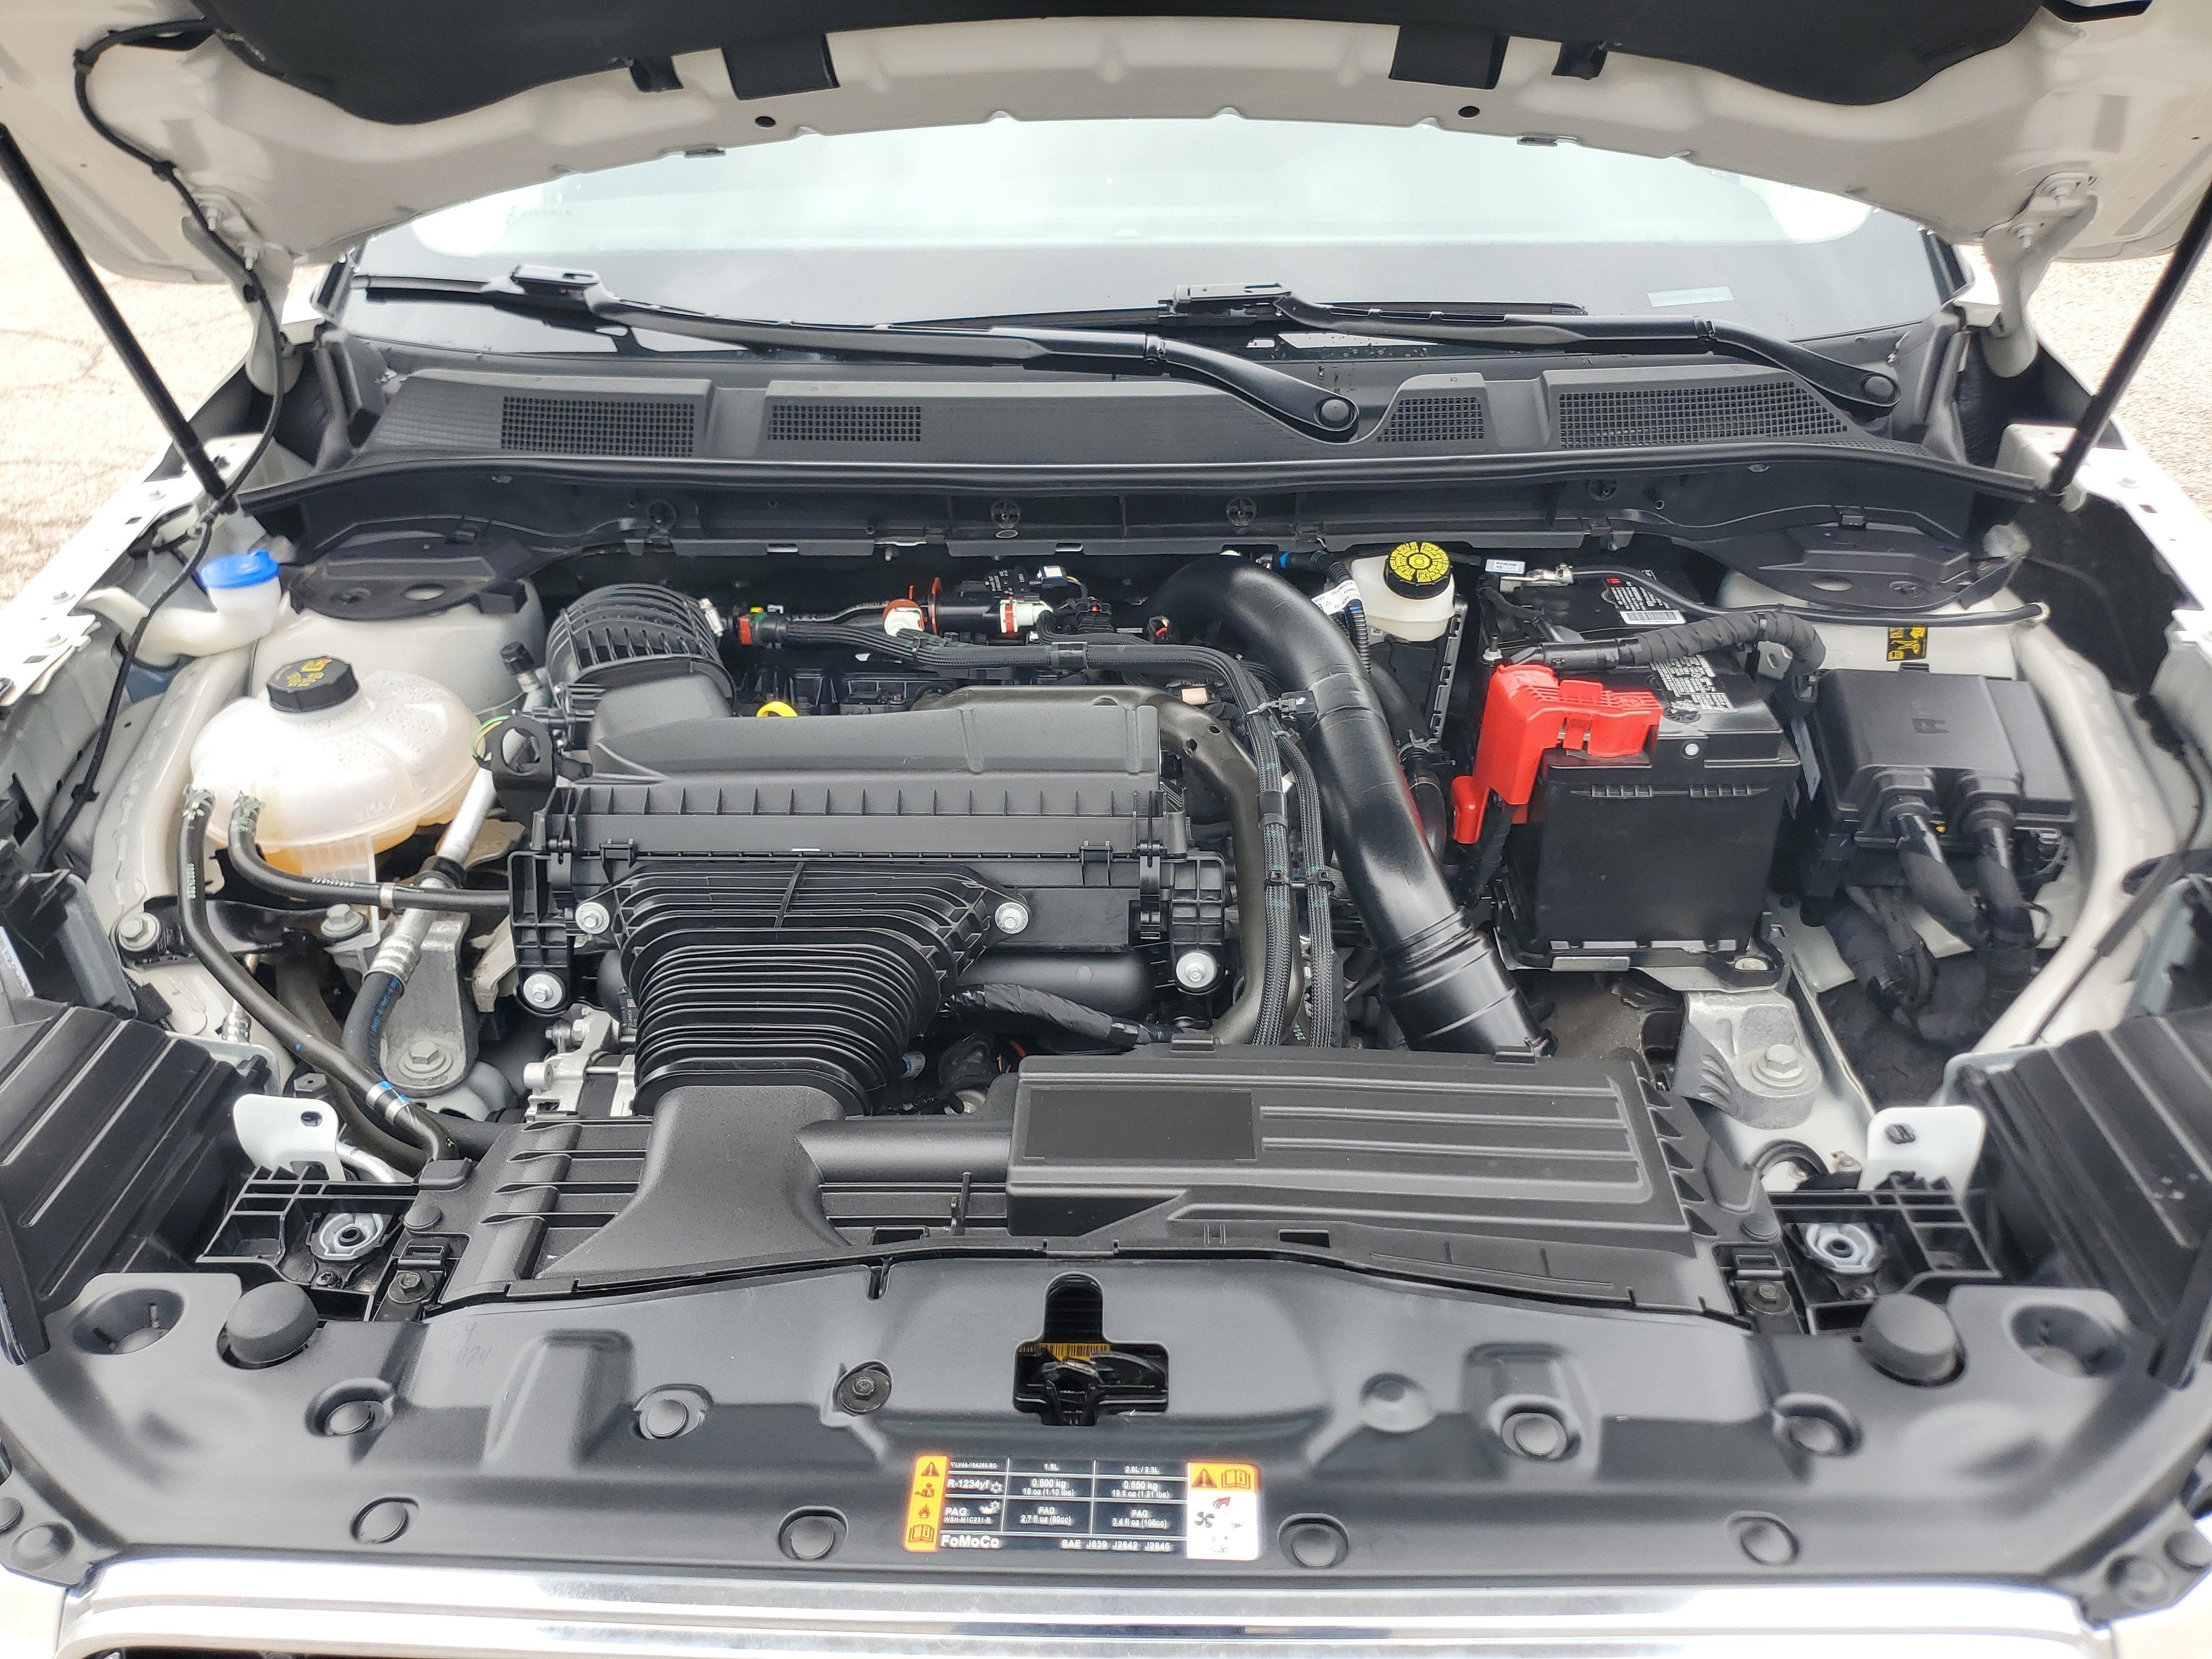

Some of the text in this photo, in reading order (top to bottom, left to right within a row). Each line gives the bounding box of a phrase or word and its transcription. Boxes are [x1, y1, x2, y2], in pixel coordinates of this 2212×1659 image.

[947, 1479, 990, 1490] R-1234yf
[1032, 1479, 1066, 1488] 0.500 kg
[1124, 1481, 1158, 1491] 0.550 kg
[1061, 1488, 1074, 1496] lbs)
[1138, 1490, 1154, 1498] (1.21
[945, 1507, 967, 1516] PAG
[1141, 1518, 1167, 1529] (100cc)
[941, 1534, 1000, 1547] FoMoCo
[1086, 1539, 1108, 1548] J639
[1112, 1541, 1138, 1549] J2842
